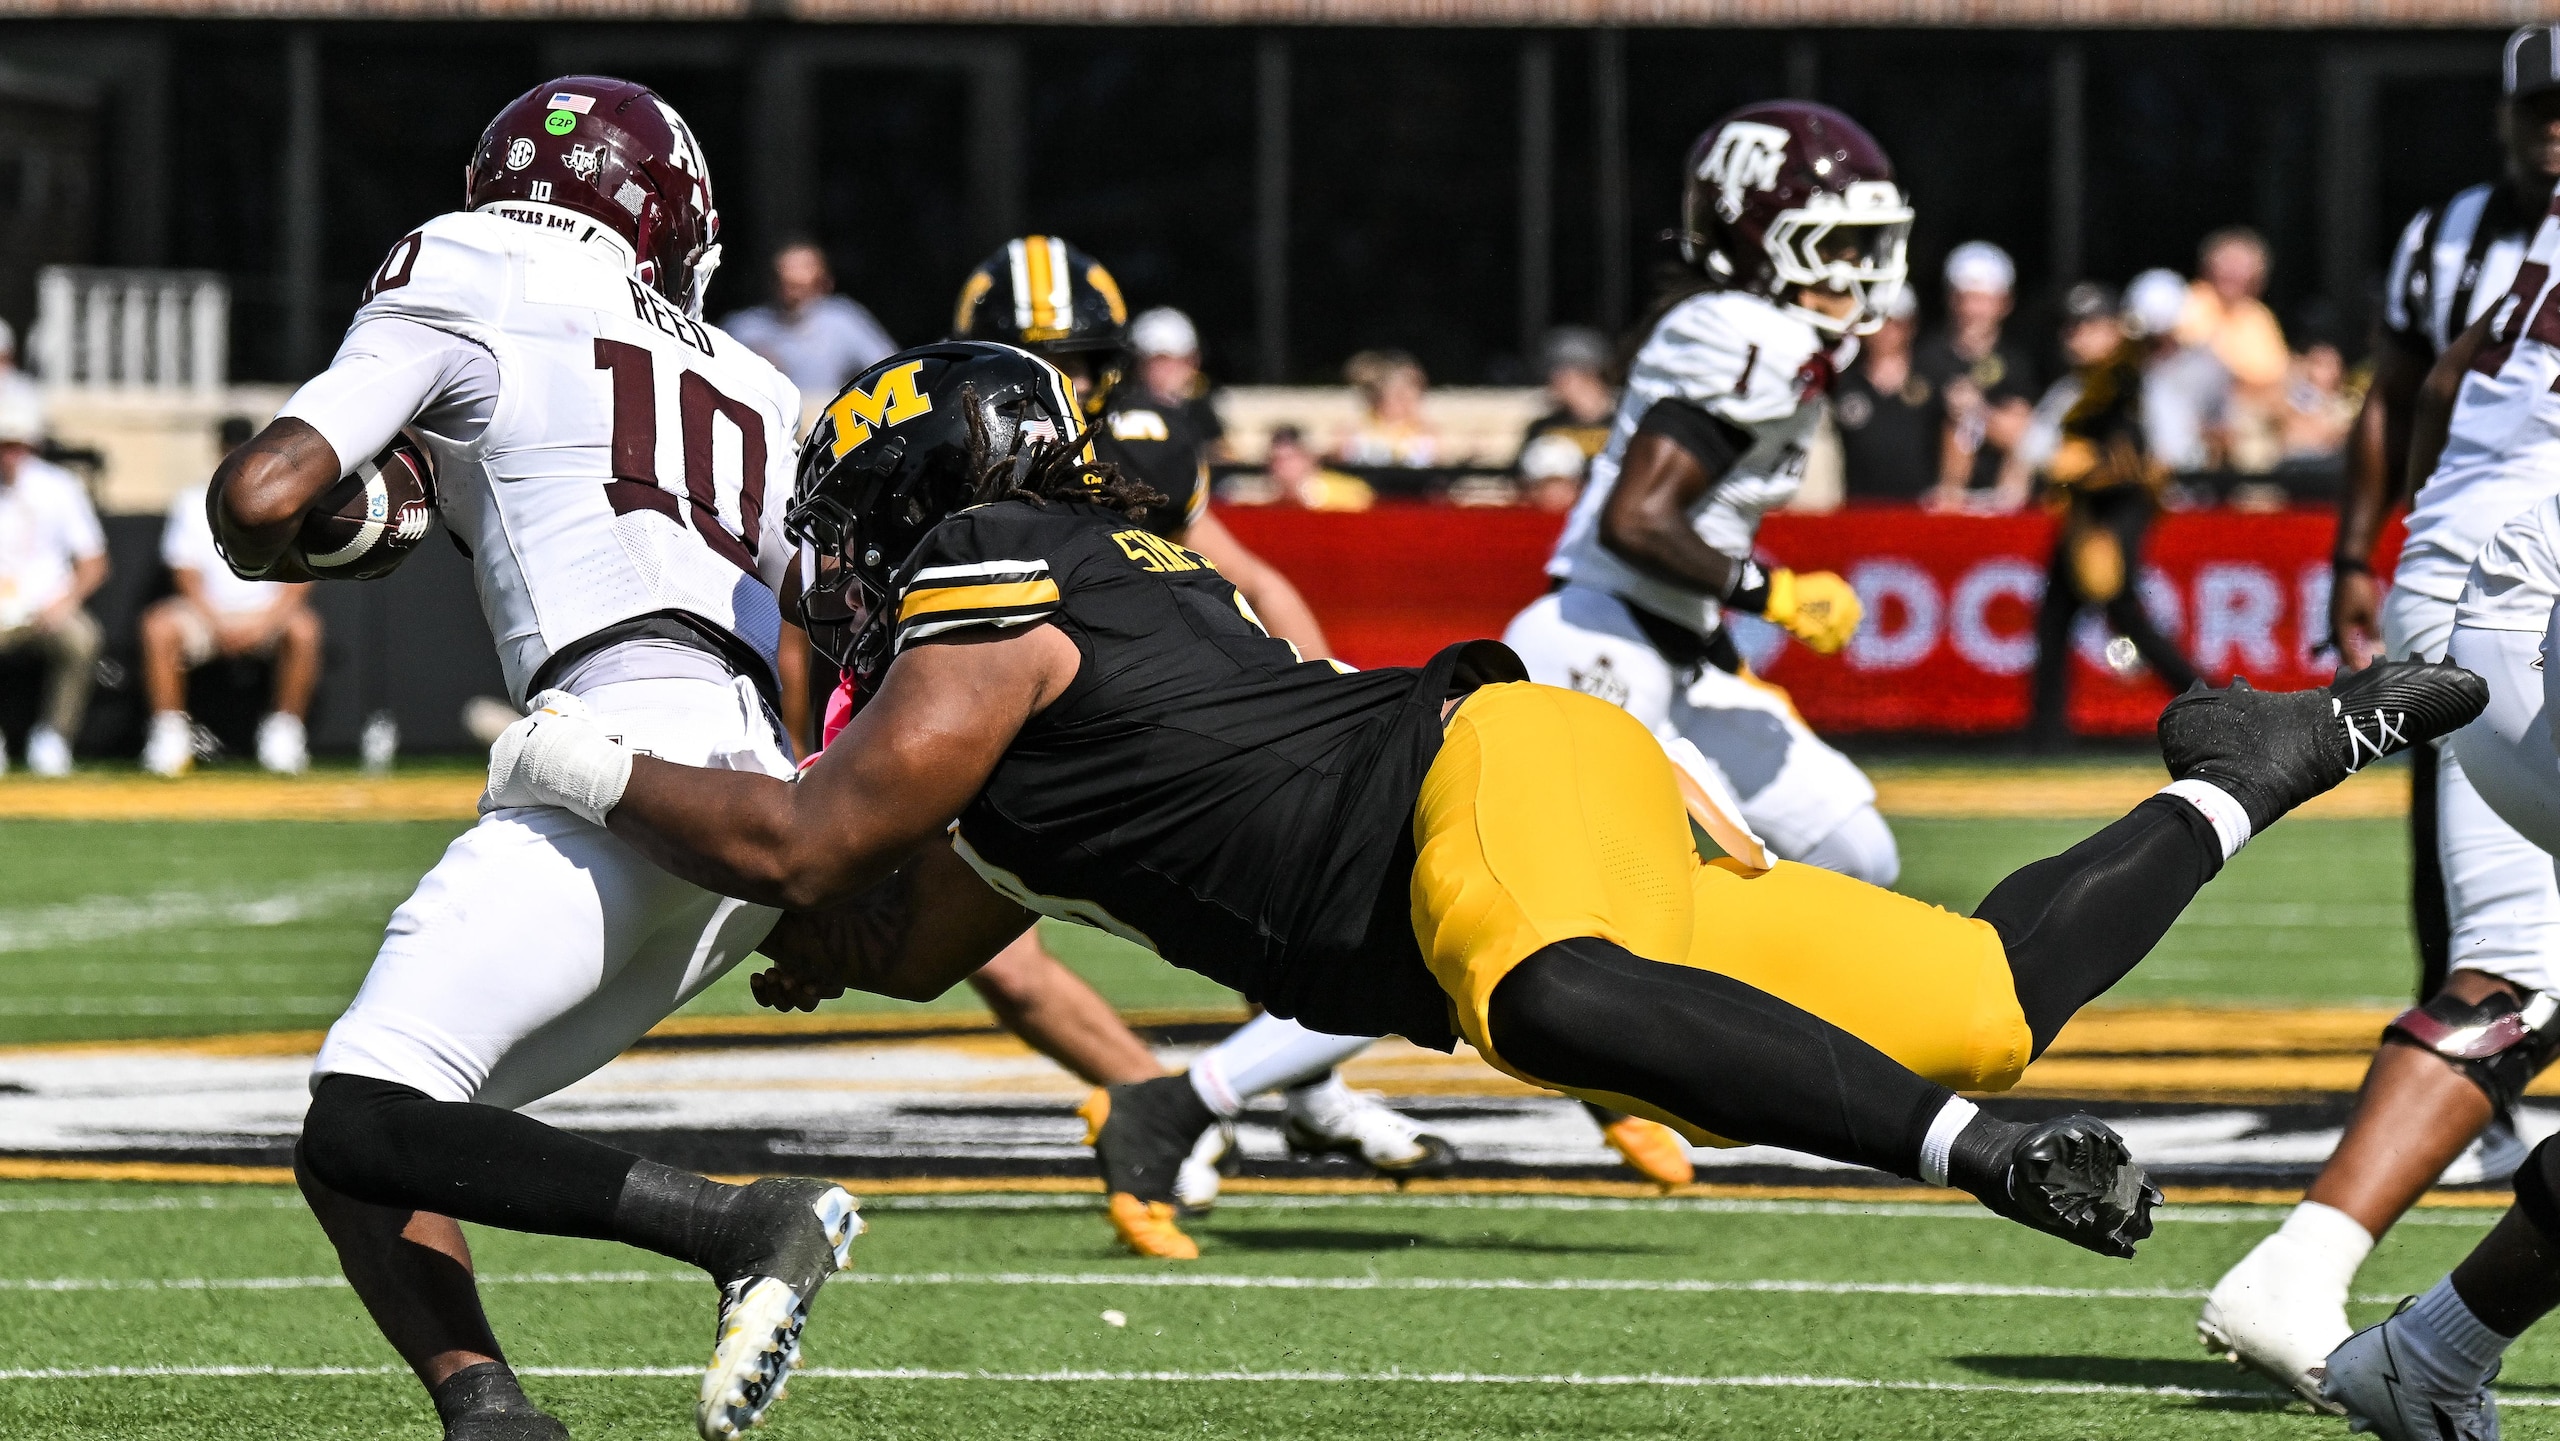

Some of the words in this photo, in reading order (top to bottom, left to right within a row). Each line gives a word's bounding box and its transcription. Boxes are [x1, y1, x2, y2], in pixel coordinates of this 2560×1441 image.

[548, 116, 573, 128] C2P
[507, 140, 533, 168] SEC
[529, 180, 553, 202] 10
[500, 208, 543, 226] TEXAS
[546, 214, 576, 233] A&M
[626, 276, 715, 358] REED
[1736, 344, 1760, 394] 1
[826, 359, 933, 462] M
[593, 337, 772, 591] 10
[1111, 528, 1217, 573] SIMP
